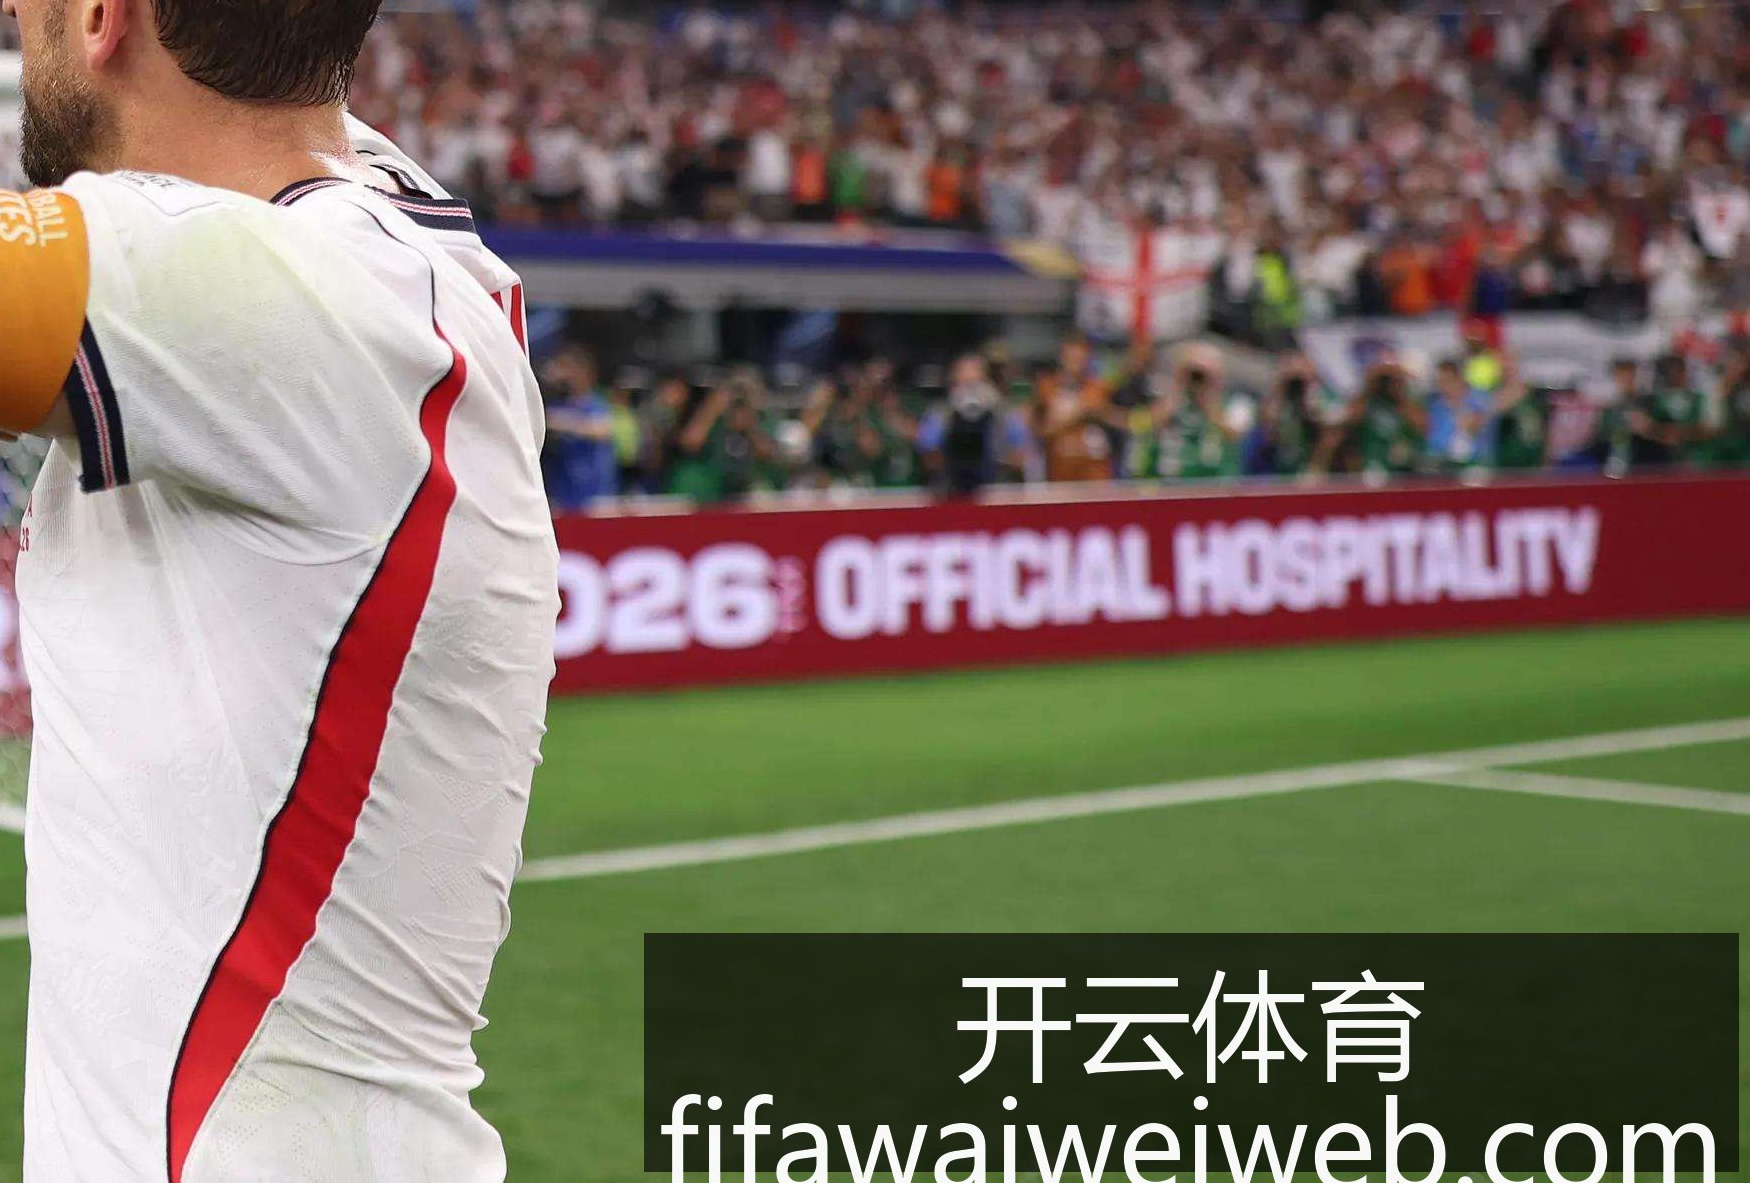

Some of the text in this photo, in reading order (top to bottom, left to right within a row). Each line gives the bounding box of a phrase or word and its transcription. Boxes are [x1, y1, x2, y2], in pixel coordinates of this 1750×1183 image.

[553, 541, 777, 660] 026
[814, 528, 1171, 640] OFFICIAL
[1173, 506, 1598, 616] HOSPITALITY
